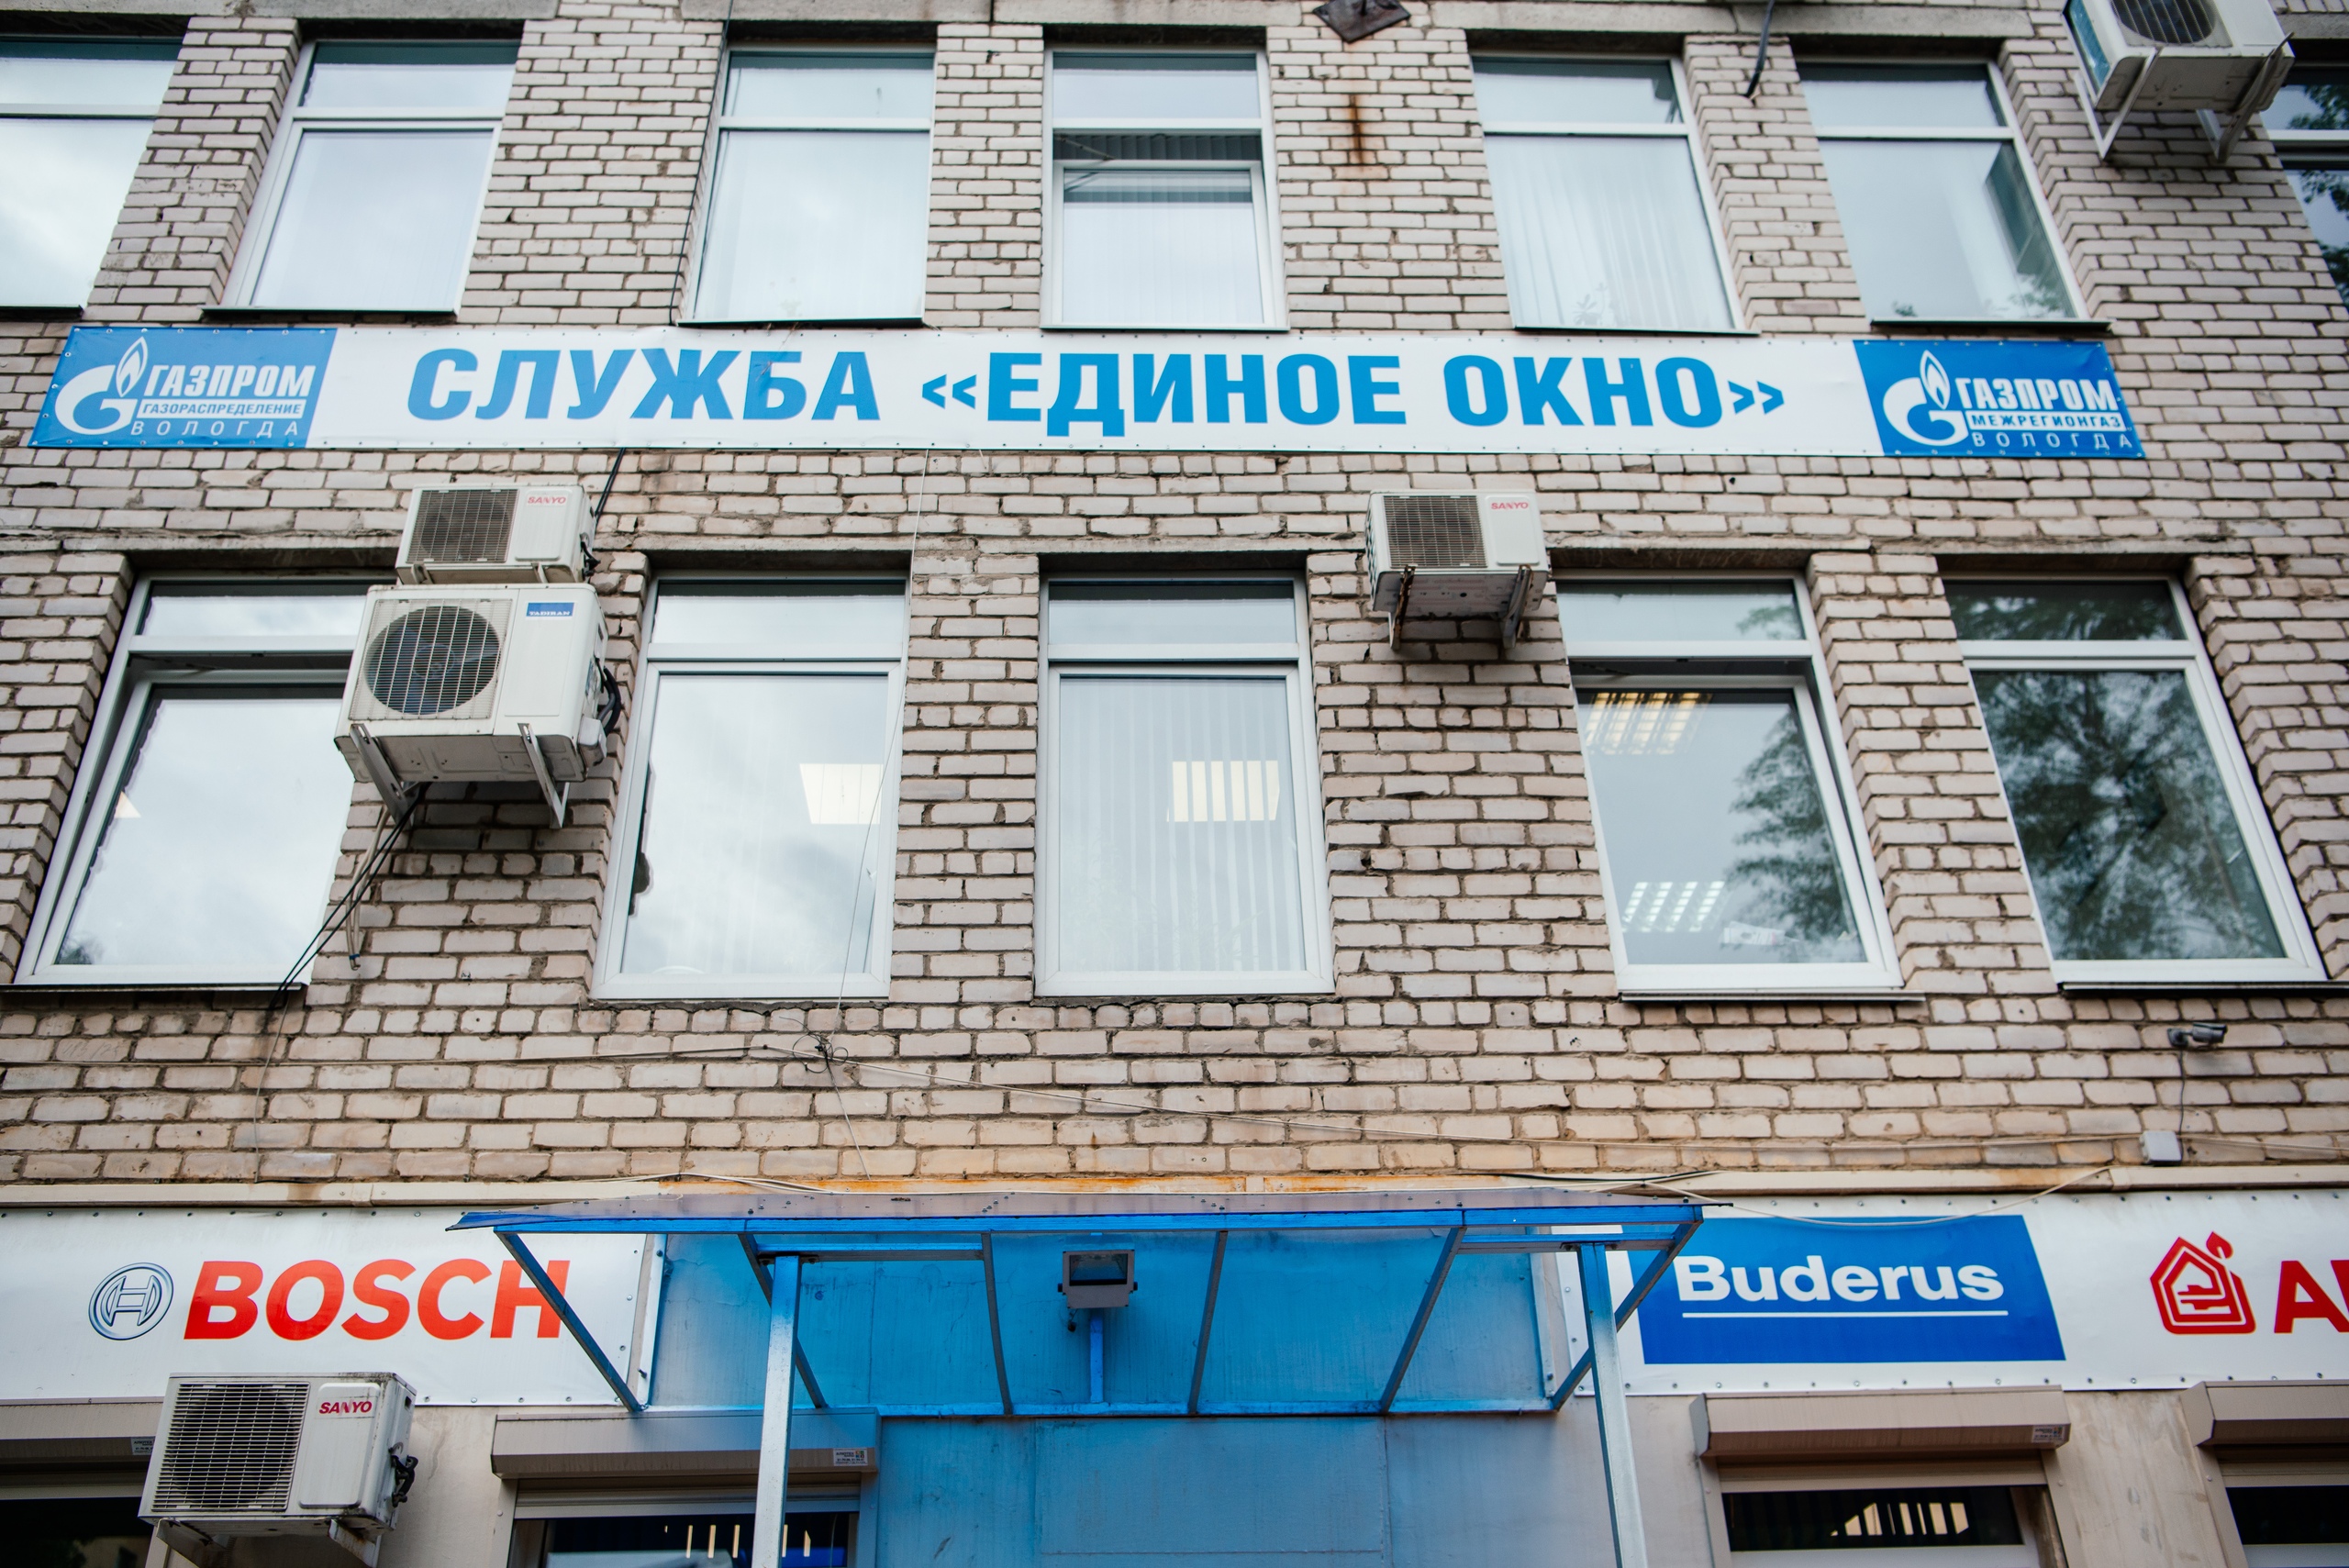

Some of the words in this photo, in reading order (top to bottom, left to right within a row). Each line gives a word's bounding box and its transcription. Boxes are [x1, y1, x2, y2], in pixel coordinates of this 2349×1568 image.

[141, 364, 317, 397] ГАЗПРОМ
[406, 348, 881, 421] СЛУЖБА
[1954, 377, 2120, 411] ГАЗПРОМ
[142, 402, 304, 416] ГАЗОРАСПРЕДЕЛЕНИЕ
[129, 419, 299, 439] ВОЛОГДА
[1970, 414, 2122, 428] МЕЖРЕГИОНГАЗ
[1971, 431, 2134, 450] ВОЛОГДА
[527, 495, 567, 505] SANYO
[1490, 501, 1530, 510] SANYO
[1672, 1254, 2005, 1303] Buderus
[183, 1258, 571, 1341] BOSCH
[318, 1400, 373, 1414] SANYO
